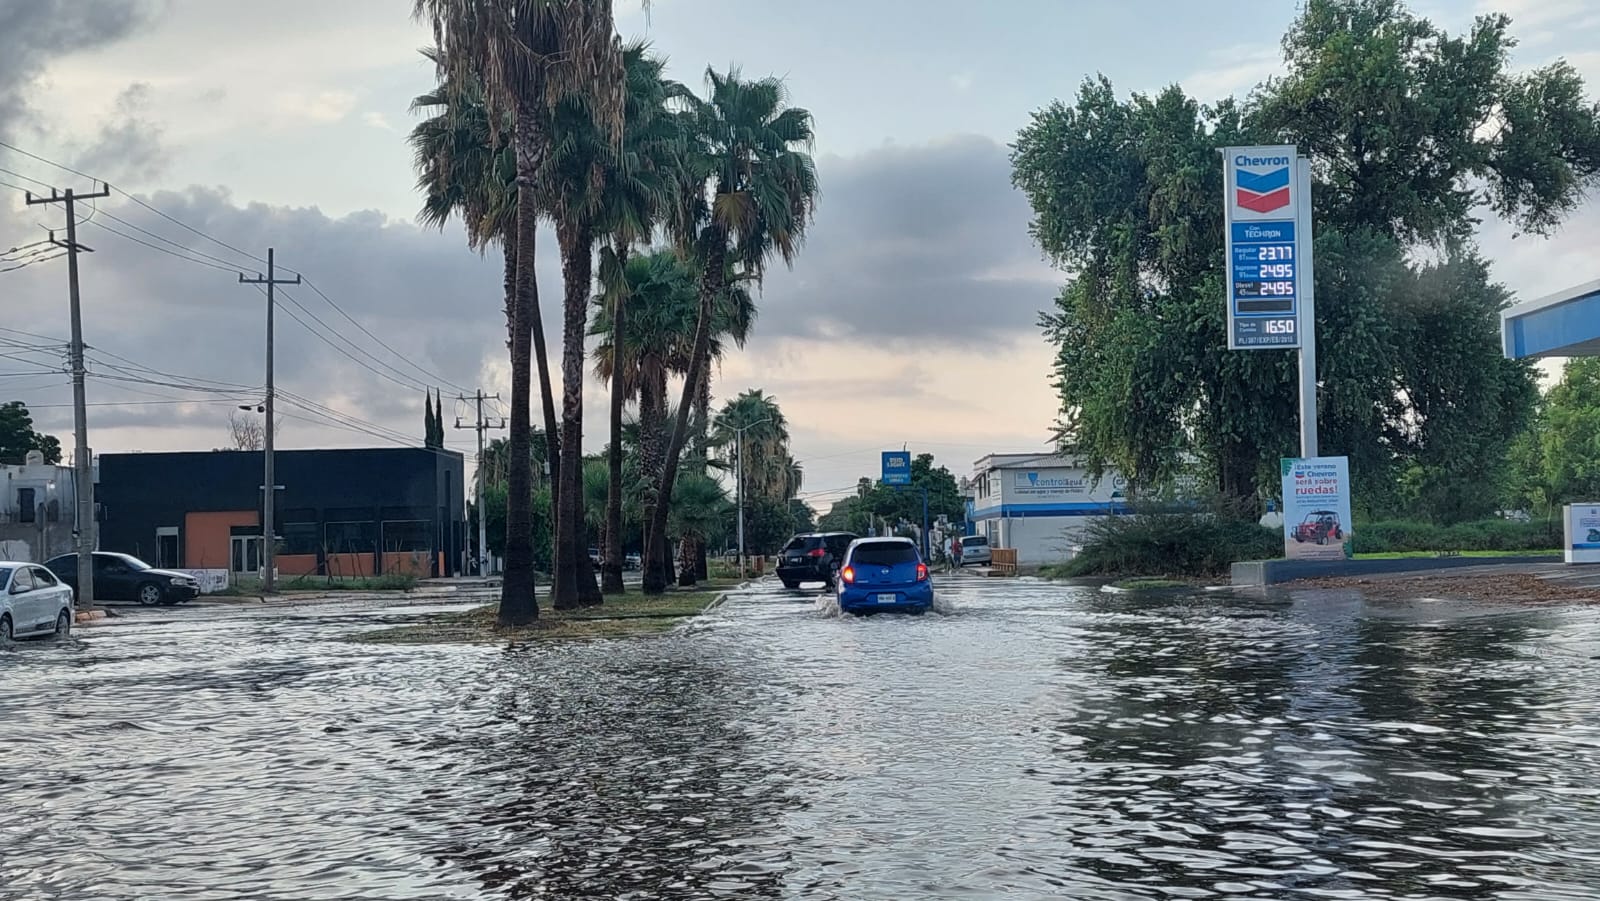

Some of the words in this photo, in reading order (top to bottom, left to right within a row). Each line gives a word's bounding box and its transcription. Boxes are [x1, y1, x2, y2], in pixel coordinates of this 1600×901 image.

[1235, 155, 1290, 167] Chevron
[1235, 281, 1254, 289] Diesel
[1306, 470, 1338, 478] Chevron
[1314, 477, 1338, 485] sobre
[1295, 485, 1338, 495] ruedas!
